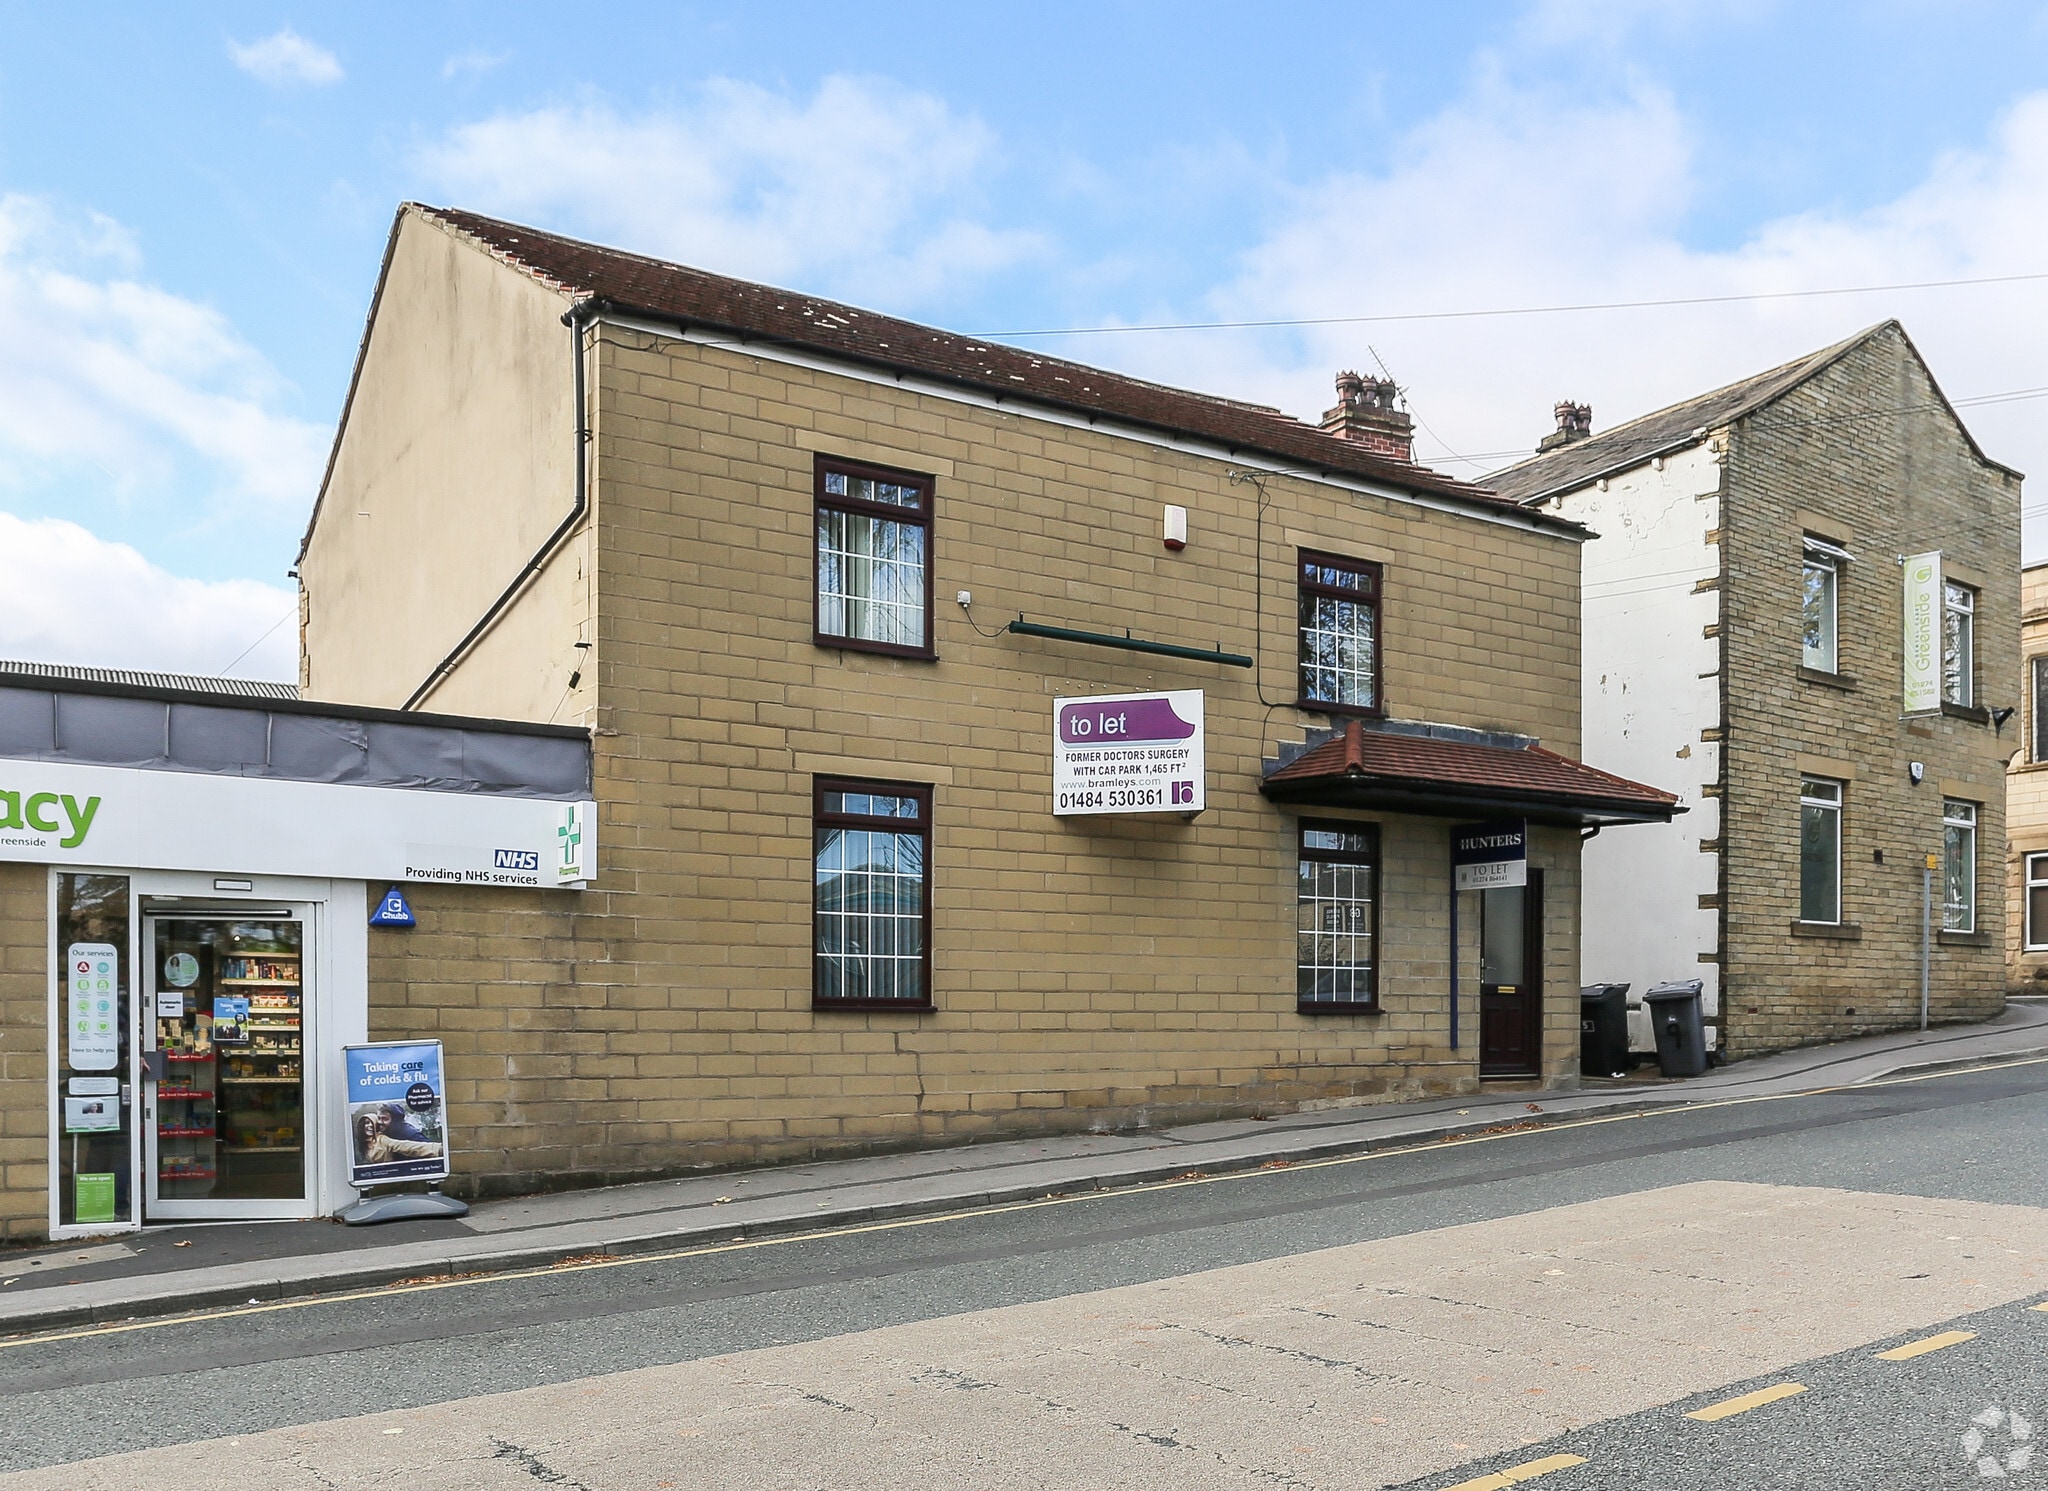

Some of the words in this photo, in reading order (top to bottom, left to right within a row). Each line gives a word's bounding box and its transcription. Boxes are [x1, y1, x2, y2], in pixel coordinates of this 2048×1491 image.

[1915, 592, 1930, 671] Greenside
[1070, 714, 1092, 736] to
[1099, 712, 1126, 734] let
[1065, 752, 1101, 762] FORMER
[1104, 750, 1145, 761] DOCTORS
[1147, 749, 1189, 760] SURGERY
[1073, 766, 1095, 776] WITH
[1098, 765, 1116, 775] CAR
[1118, 764, 1141, 774] PARK
[1145, 763, 1168, 776] 1,465
[1060, 778, 1161, 789] www.bramleys.com
[1060, 791, 1103, 808] 01484
[1108, 789, 1162, 807] 530361
[0, 789, 102, 848] acy
[1460, 833, 1522, 850] HUNTERS
[495, 851, 538, 869] NHS
[405, 867, 462, 882] Providing
[465, 871, 490, 882] NHS
[493, 872, 538, 885] services
[1472, 865, 1487, 876] TO
[1490, 864, 1508, 875] LET
[381, 911, 409, 920] Chubb
[363, 1061, 399, 1074] Taking
[401, 1061, 424, 1072] care
[360, 1075, 372, 1086] of
[374, 1074, 401, 1085] colds
[403, 1072, 413, 1083] &
[414, 1072, 428, 1082] flu
